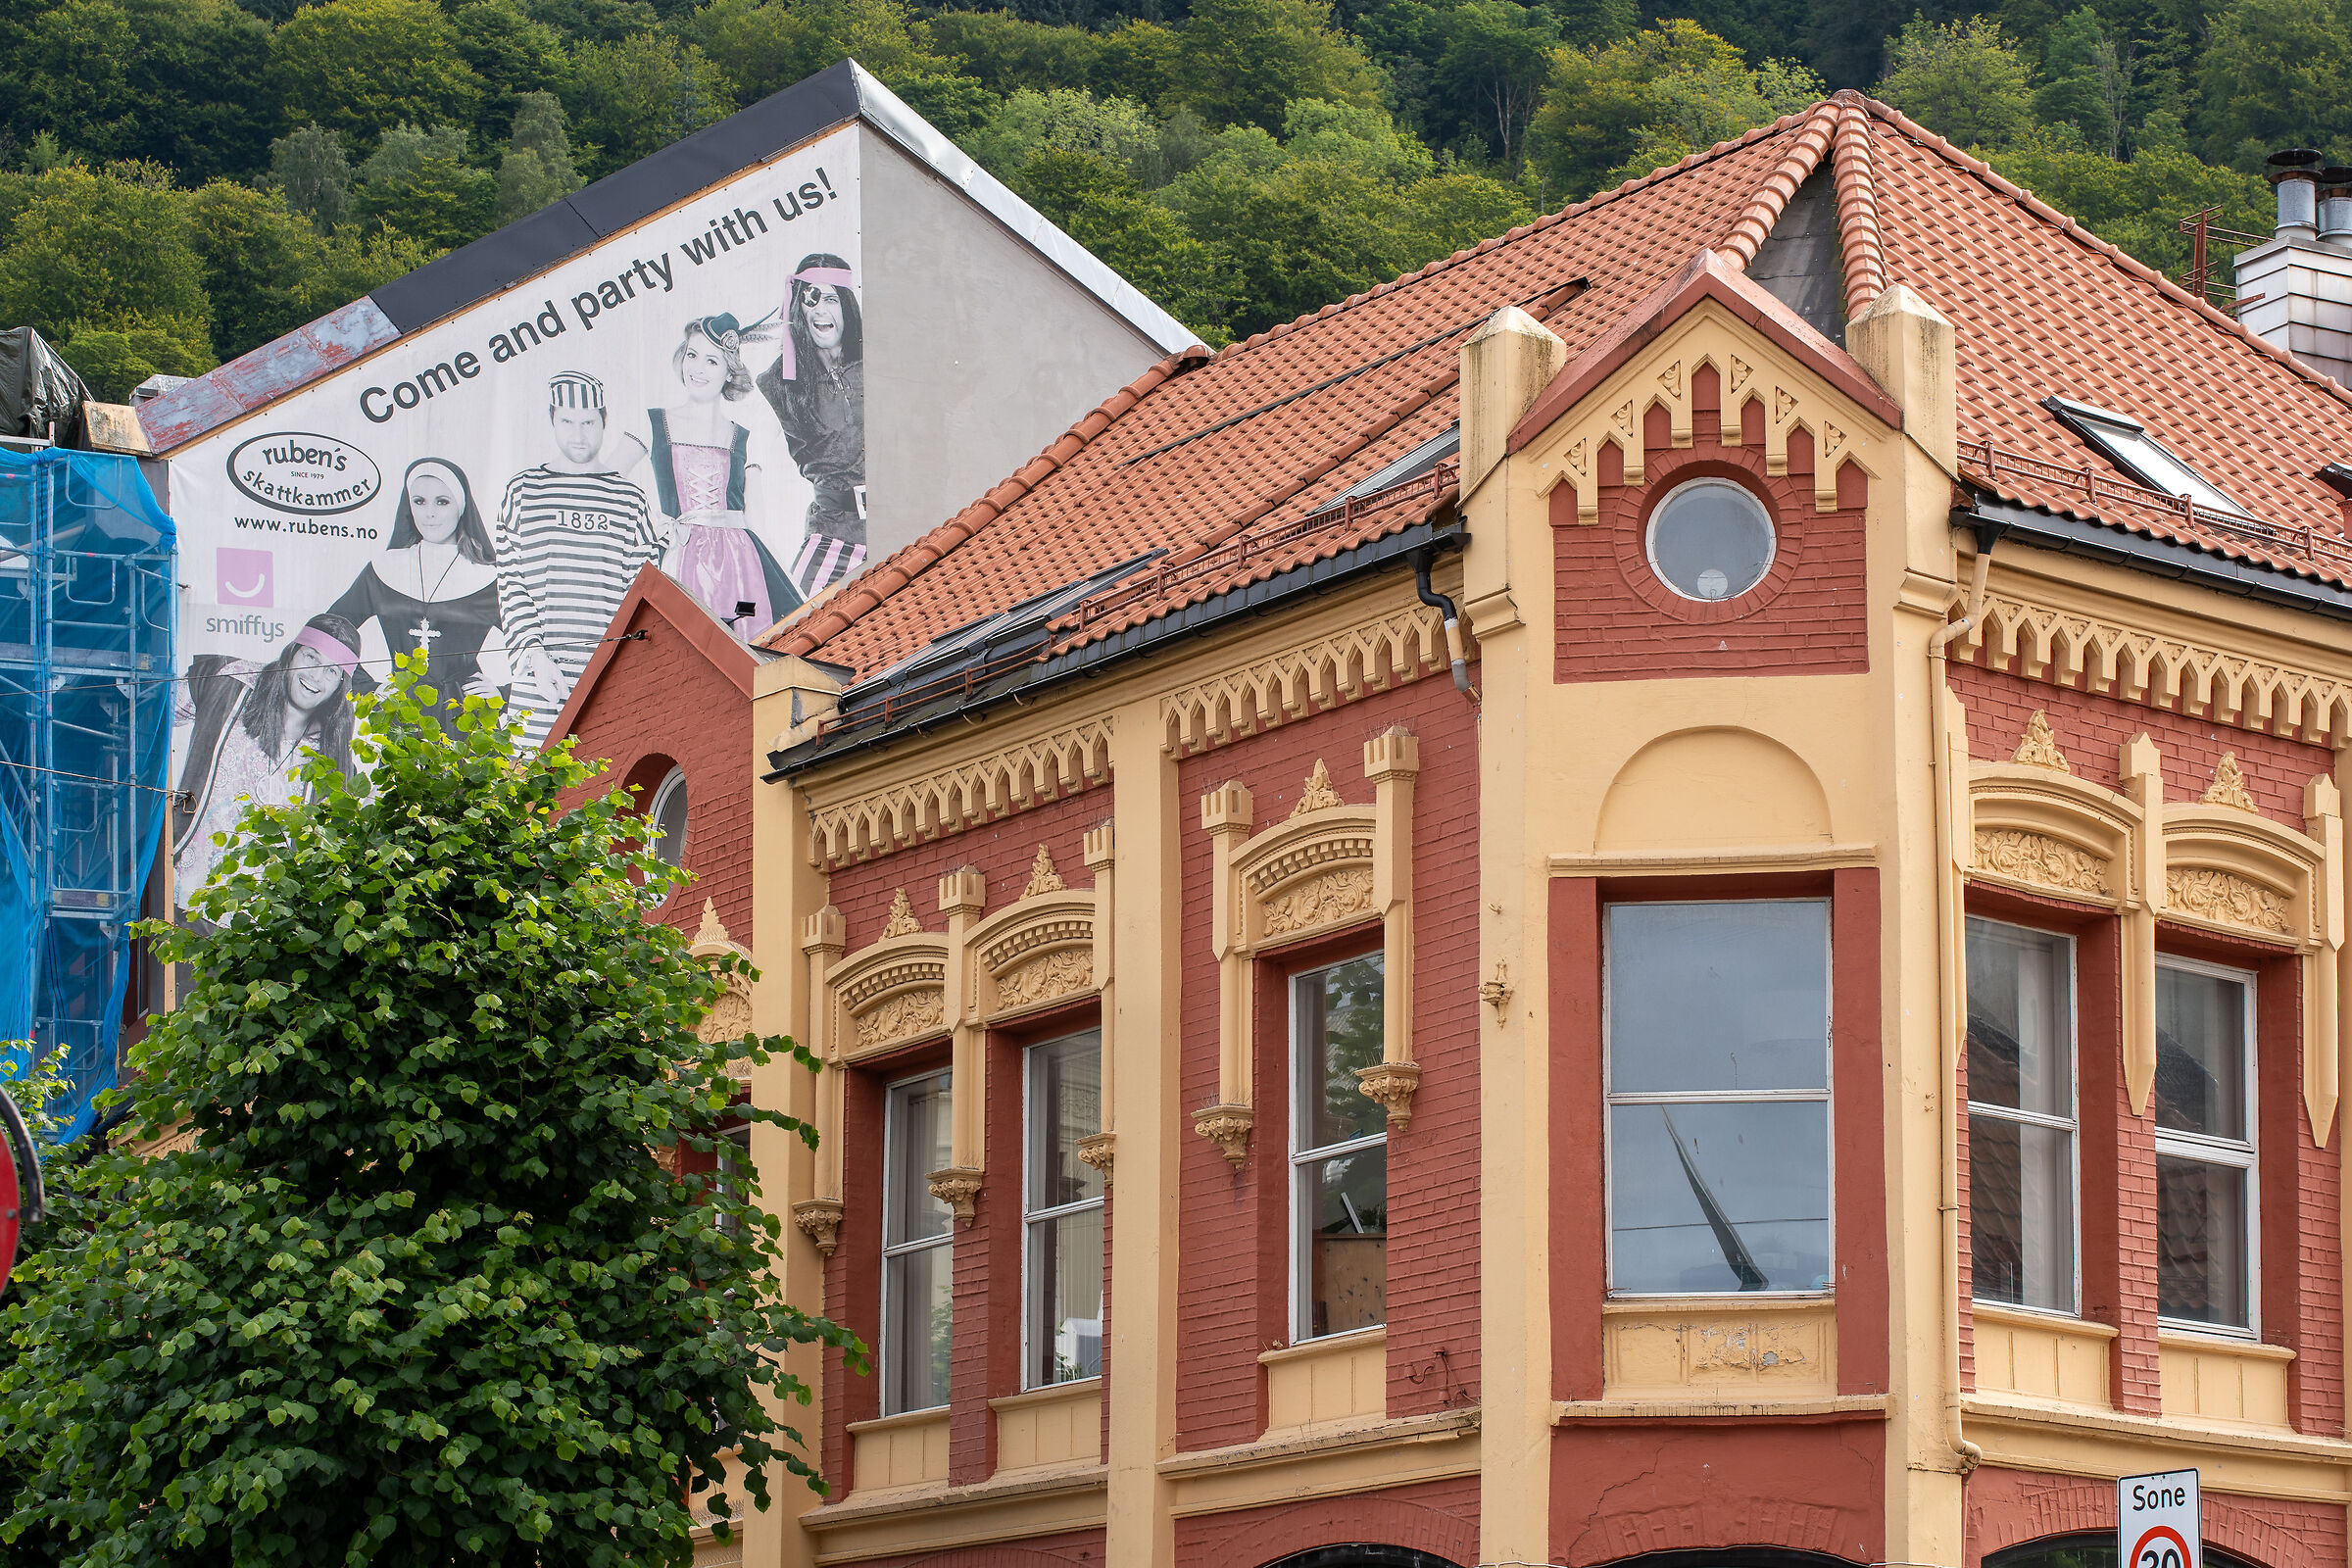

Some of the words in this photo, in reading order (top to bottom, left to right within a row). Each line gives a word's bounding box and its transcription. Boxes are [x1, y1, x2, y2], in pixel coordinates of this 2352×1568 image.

[360, 352, 480, 423] Come
[489, 300, 566, 363] and
[571, 253, 672, 330] party
[680, 208, 768, 266] with
[773, 168, 837, 220] us!
[290, 470, 309, 479] SINCE
[243, 470, 370, 506] skattkammer
[234, 517, 377, 540] www.rubens.no
[559, 510, 608, 530] 1832
[206, 613, 284, 643] smiffys
[2132, 1485, 2185, 1511] Sone
